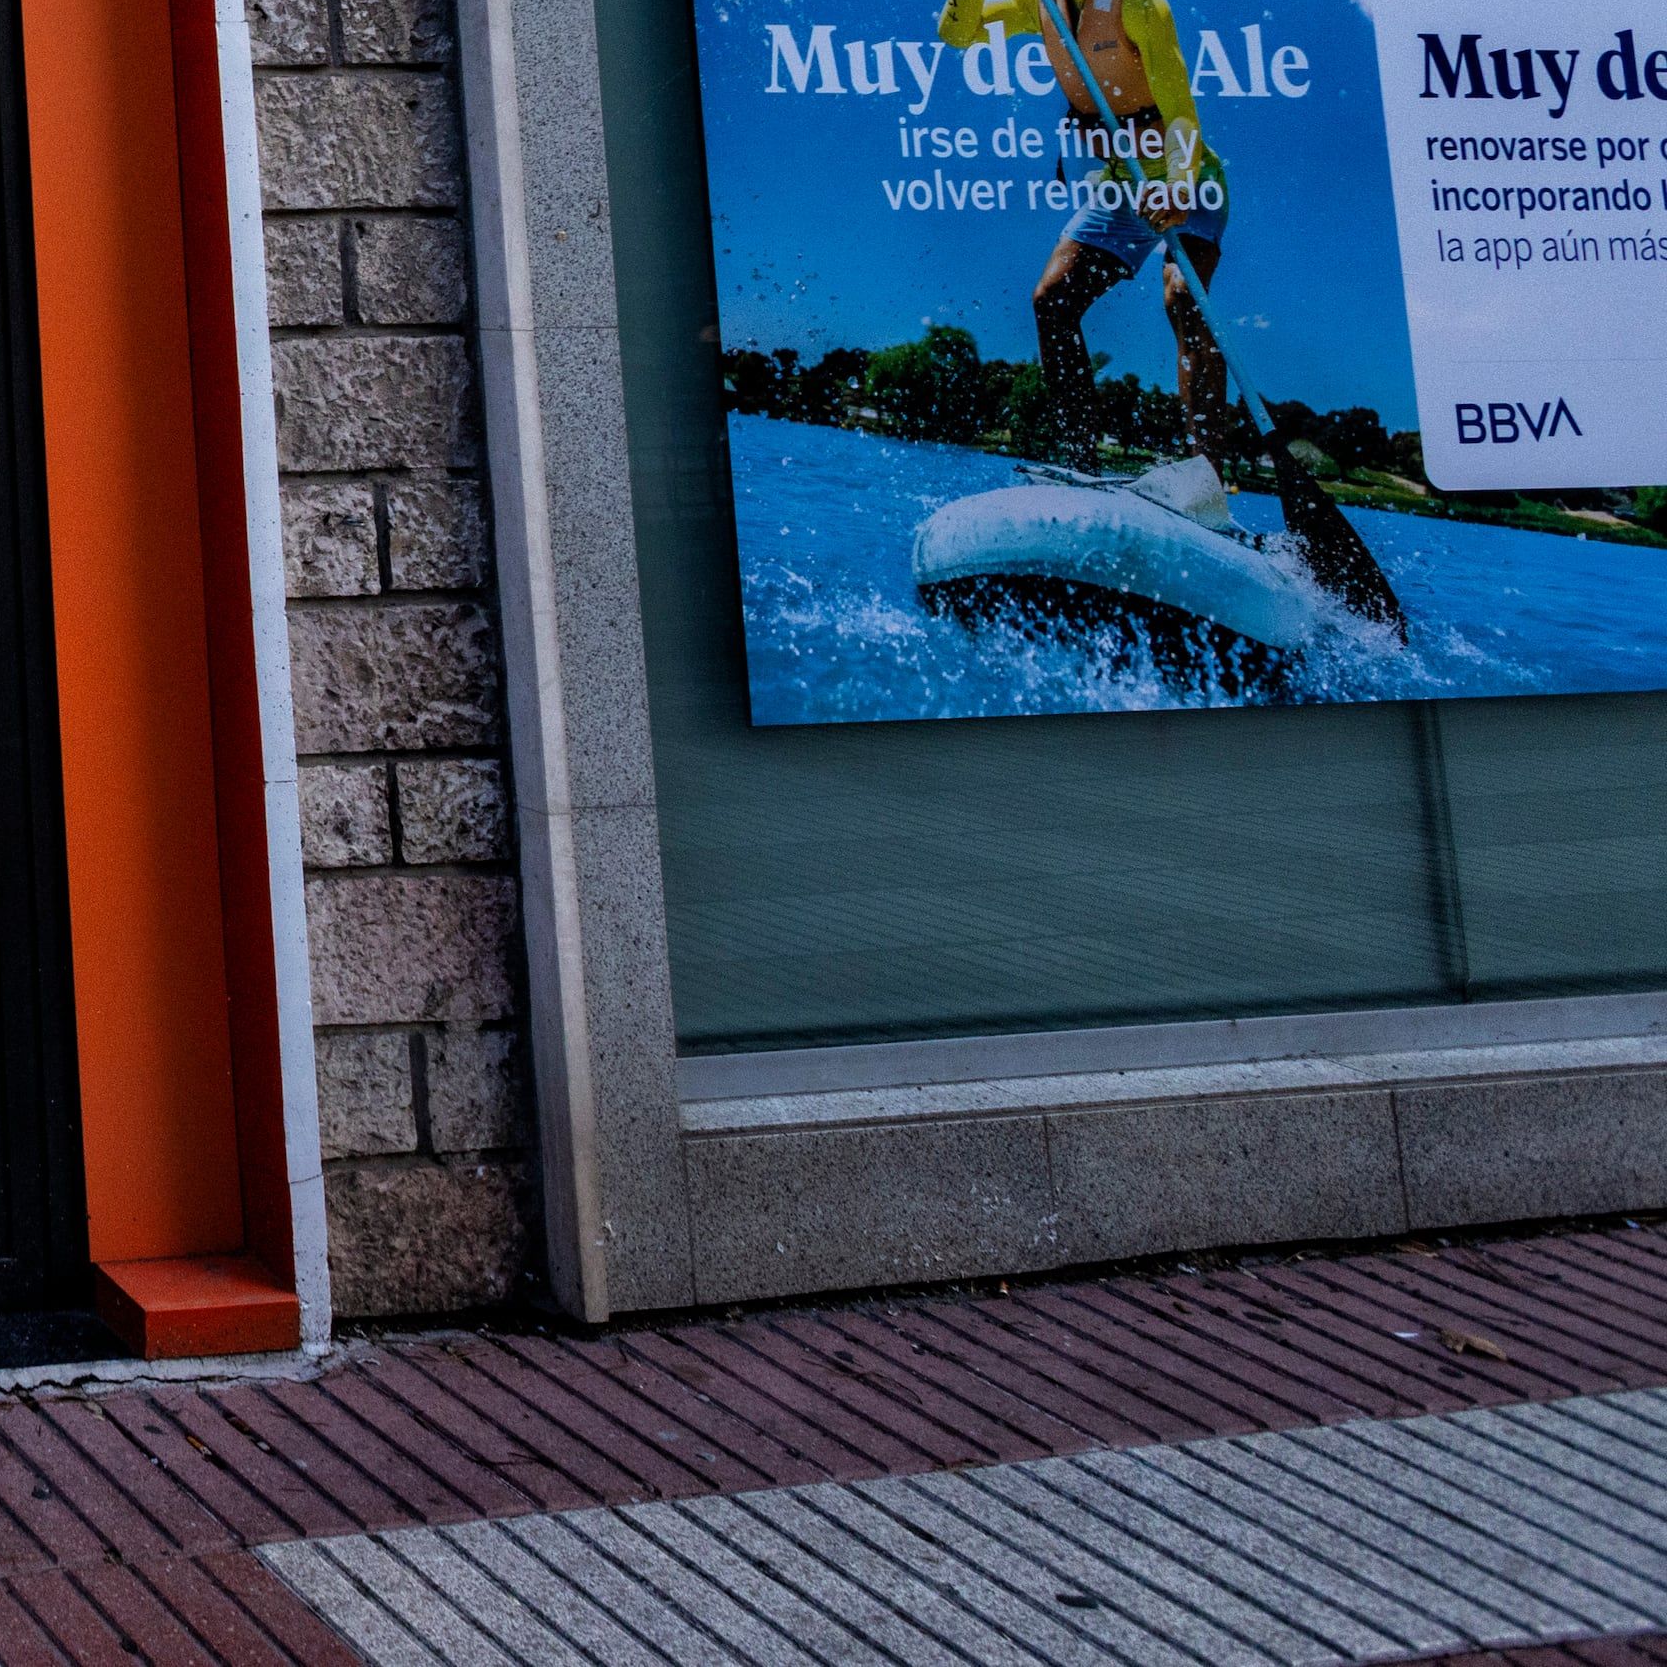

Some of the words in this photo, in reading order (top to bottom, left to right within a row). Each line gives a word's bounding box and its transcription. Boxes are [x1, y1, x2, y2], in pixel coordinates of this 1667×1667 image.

[765, 23, 946, 115] Muy
[963, 21, 1056, 97] de
[1190, 23, 1311, 98] Ale
[1417, 33, 1580, 119] Muy
[898, 117, 979, 159] irse
[991, 118, 1044, 159] de
[1055, 118, 1164, 159] finde
[1177, 130, 1199, 170] y
[1426, 136, 1587, 161] renovarse
[1596, 137, 1649, 169] por
[882, 170, 1014, 211] volver
[1028, 170, 1225, 211] renovado
[1431, 179, 1652, 219] incorporando
[1438, 230, 1464, 262] la
[1474, 237, 1533, 270] app
[1542, 229, 1600, 262] aún
[1455, 396, 1584, 444] BBVA
